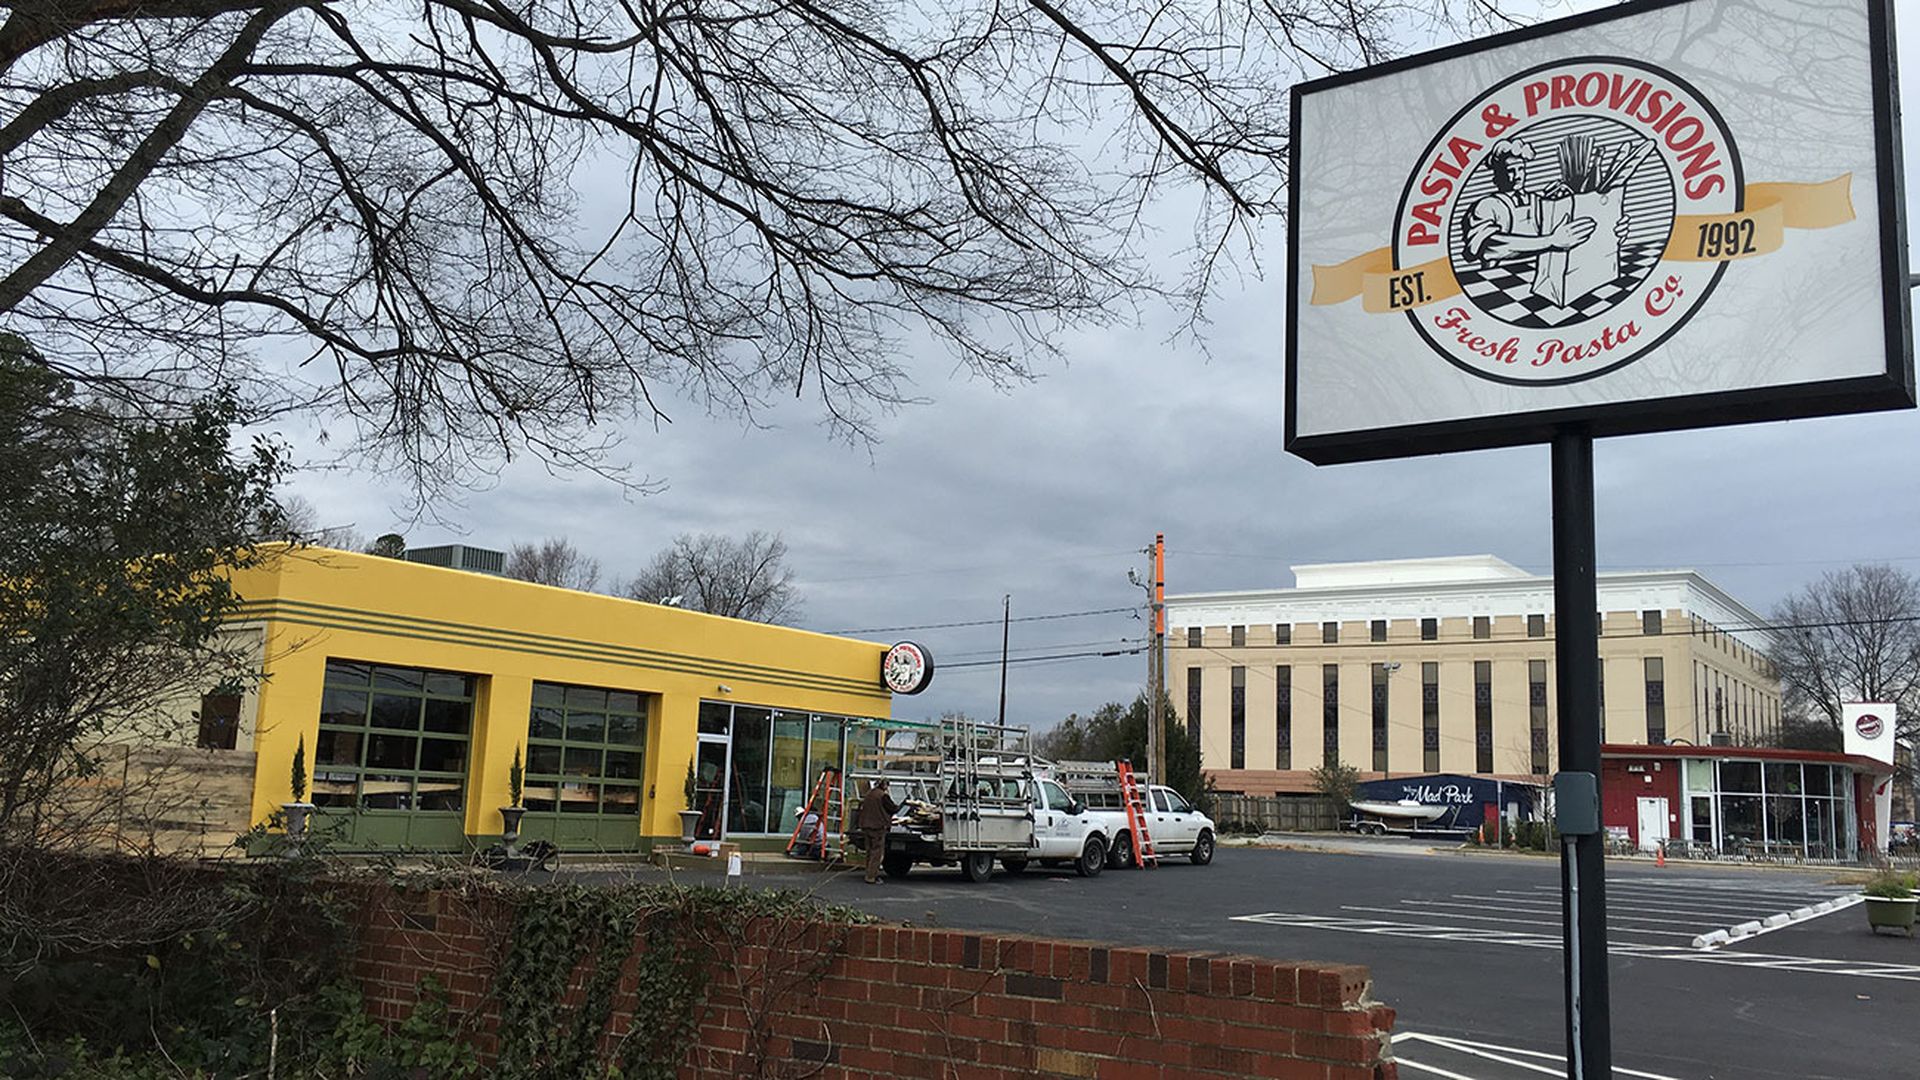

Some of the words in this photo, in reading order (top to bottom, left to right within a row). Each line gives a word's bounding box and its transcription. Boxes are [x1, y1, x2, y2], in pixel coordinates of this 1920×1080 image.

[1407, 135, 1482, 247] PASTA
[1481, 103, 1518, 138] &
[1524, 71, 1726, 202] PROVISIONS
[1697, 218, 1758, 259] 1992
[1388, 271, 1432, 310] EST.
[1433, 307, 1518, 364] Fresh
[1532, 320, 1642, 367] Pasta
[1413, 784, 1442, 803] Mad
[1442, 784, 1473, 804] Park
